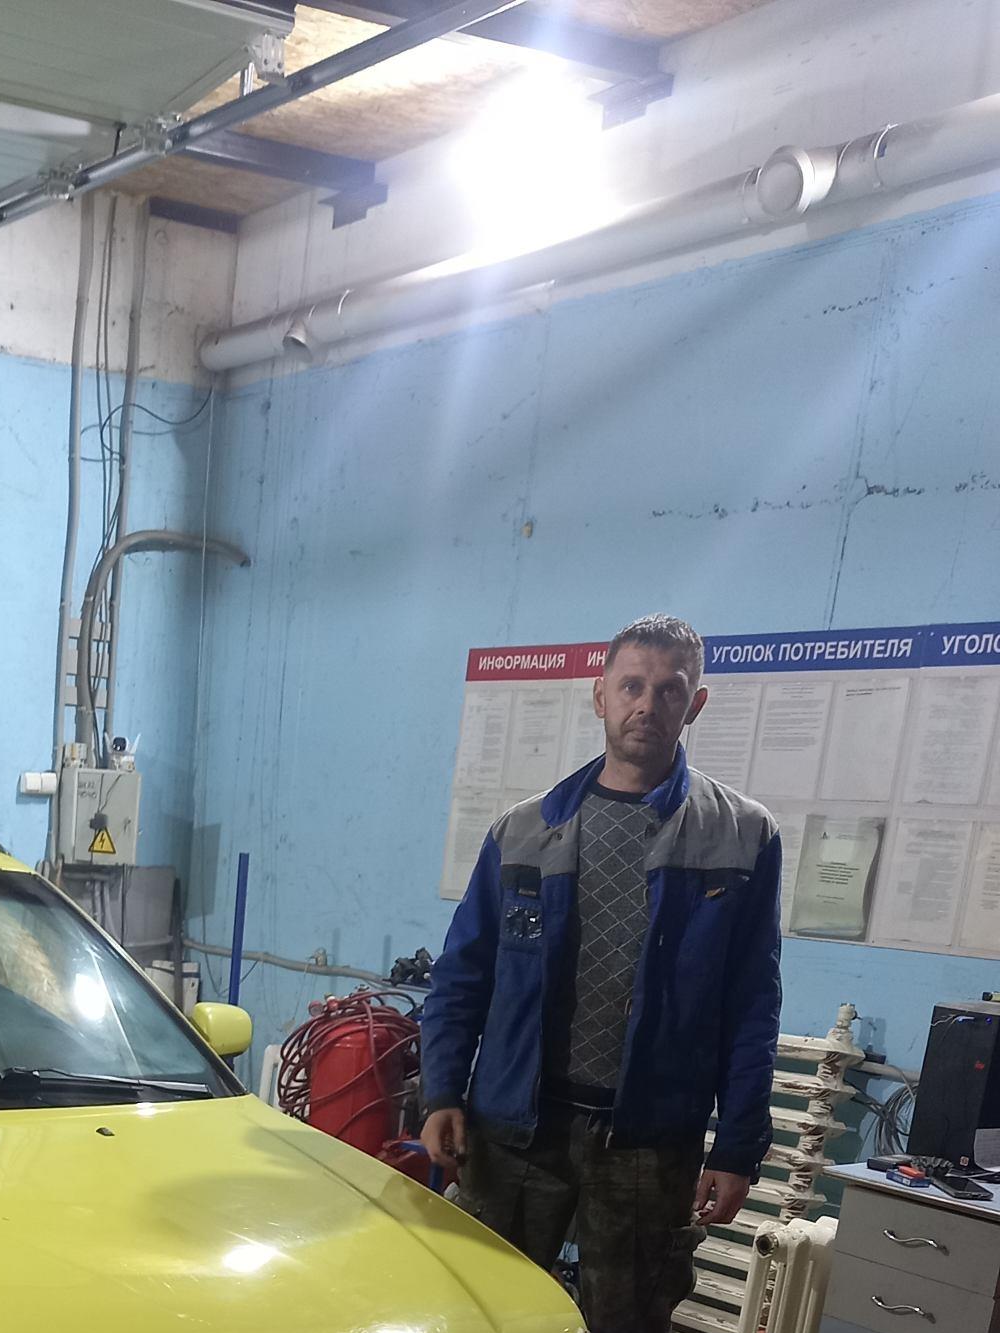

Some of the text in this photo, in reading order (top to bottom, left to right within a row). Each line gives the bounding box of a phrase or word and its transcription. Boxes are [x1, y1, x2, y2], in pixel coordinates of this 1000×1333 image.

[478, 652, 567, 672] ИНФОРМАЦИЯ
[711, 638, 913, 664] УГОЛОК ПОТРЕБИТЕЛЯ
